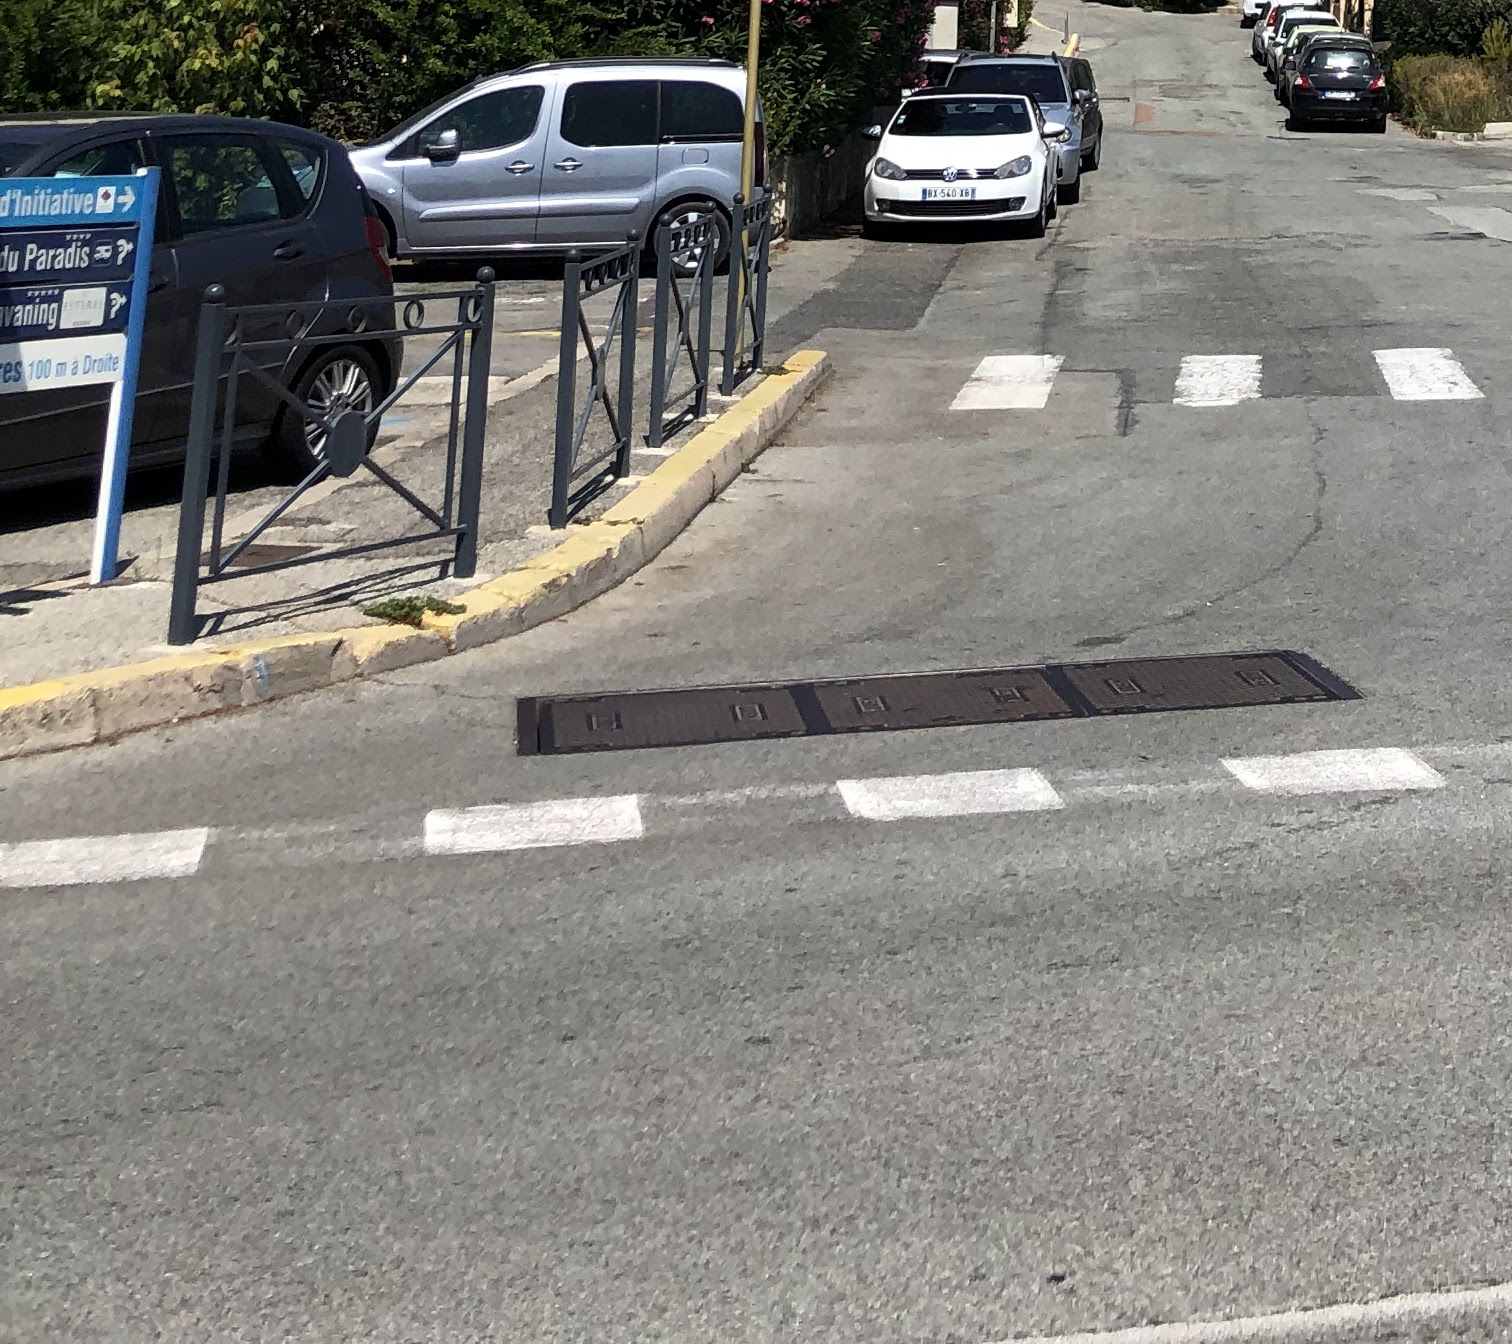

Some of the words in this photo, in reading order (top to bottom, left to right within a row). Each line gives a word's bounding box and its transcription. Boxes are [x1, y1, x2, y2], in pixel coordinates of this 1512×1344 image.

[0, 185, 94, 217] d'Initiative
[24, 242, 90, 272] Paradis
[28, 358, 52, 380] 100
[55, 361, 67, 377] m
[83, 353, 119, 375] Droite
